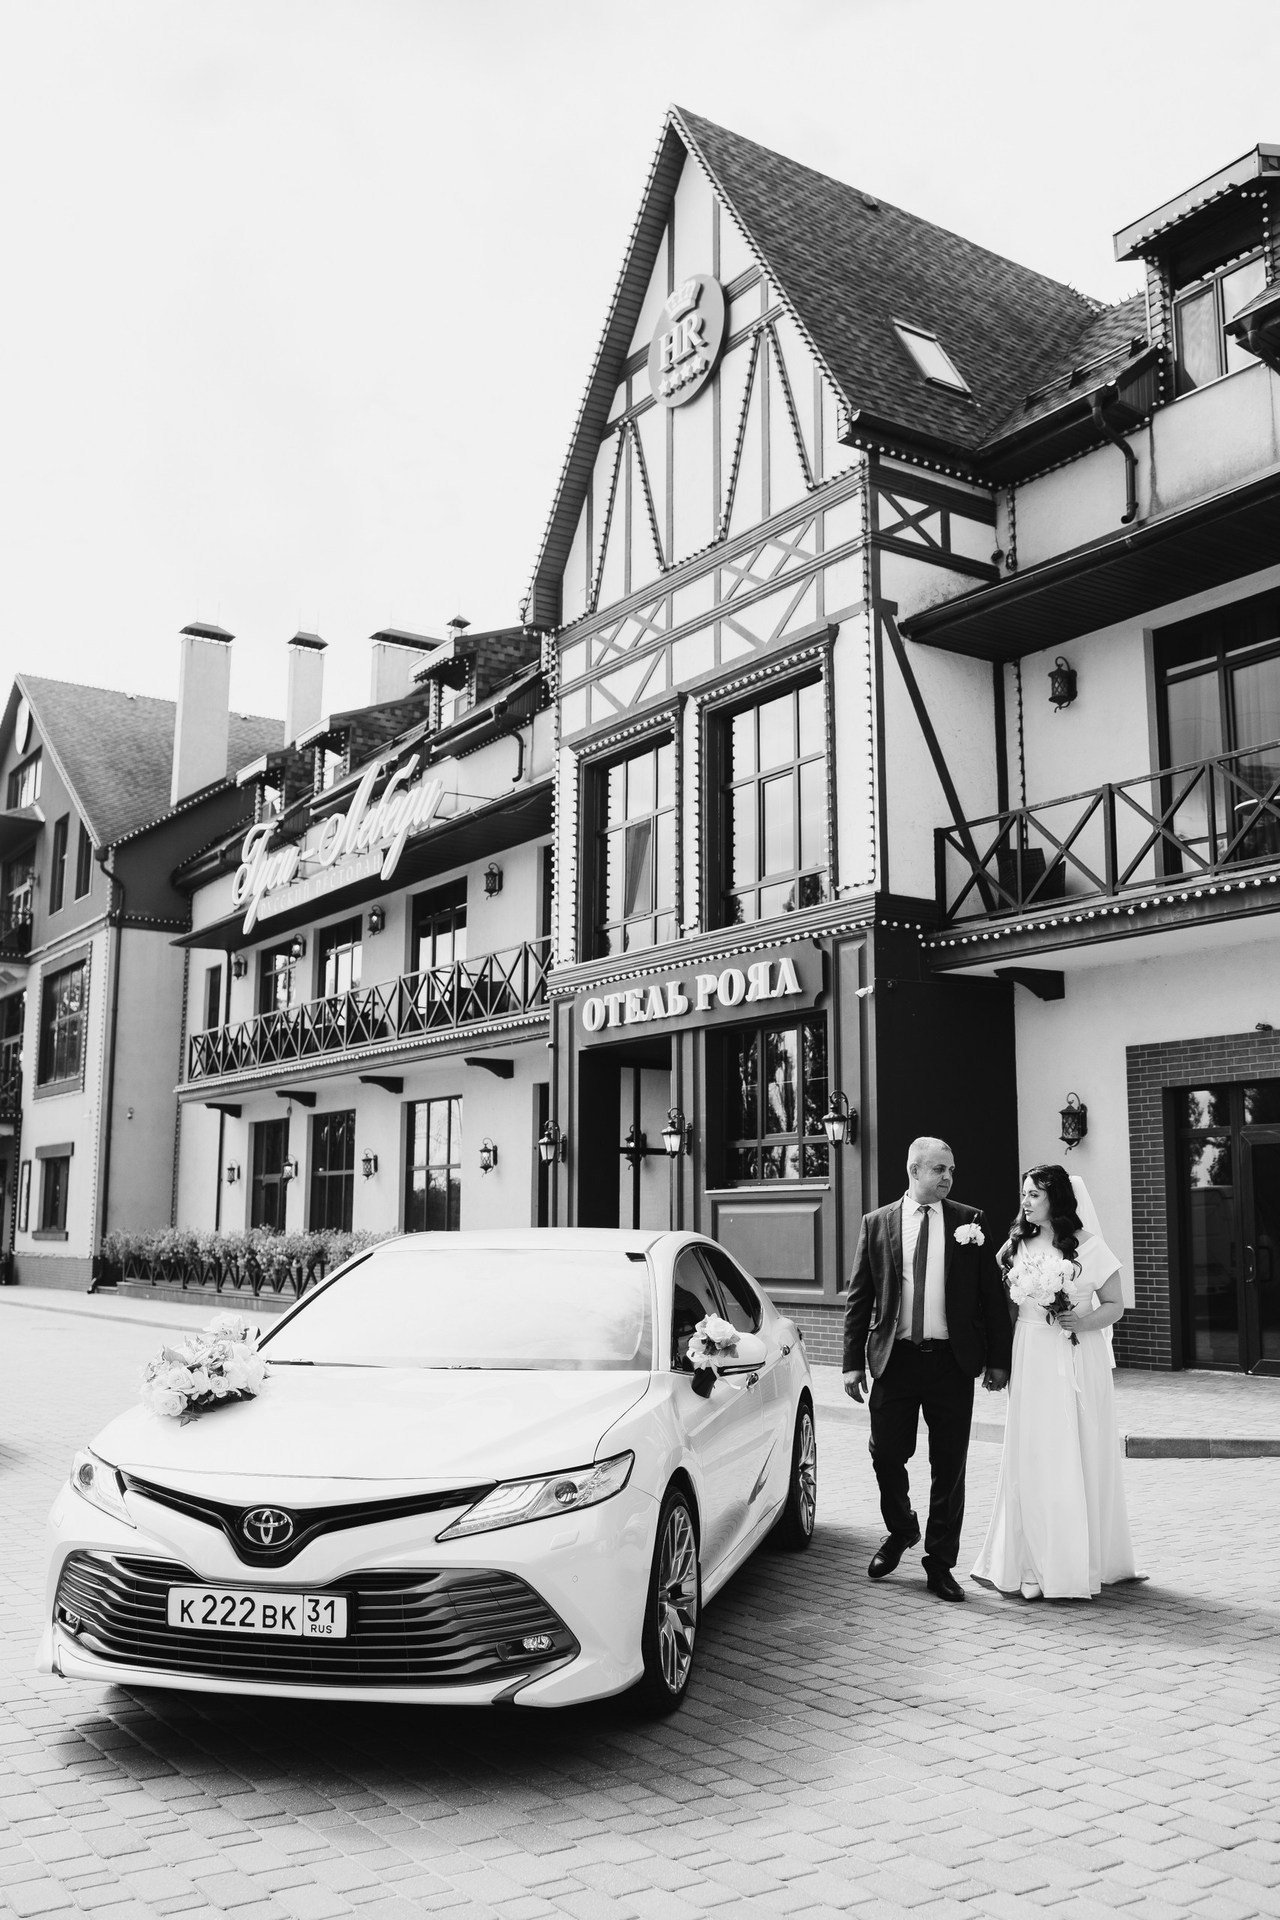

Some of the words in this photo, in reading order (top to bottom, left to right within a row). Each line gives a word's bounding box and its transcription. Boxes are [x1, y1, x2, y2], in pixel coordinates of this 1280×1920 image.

[315, 853, 382, 896] РЕСТОРАН
[582, 980, 689, 1032] ОТЕЛЬ
[695, 957, 803, 1011] РОЯЛ
[307, 1598, 335, 1624] 31
[310, 1624, 333, 1634] RUS
